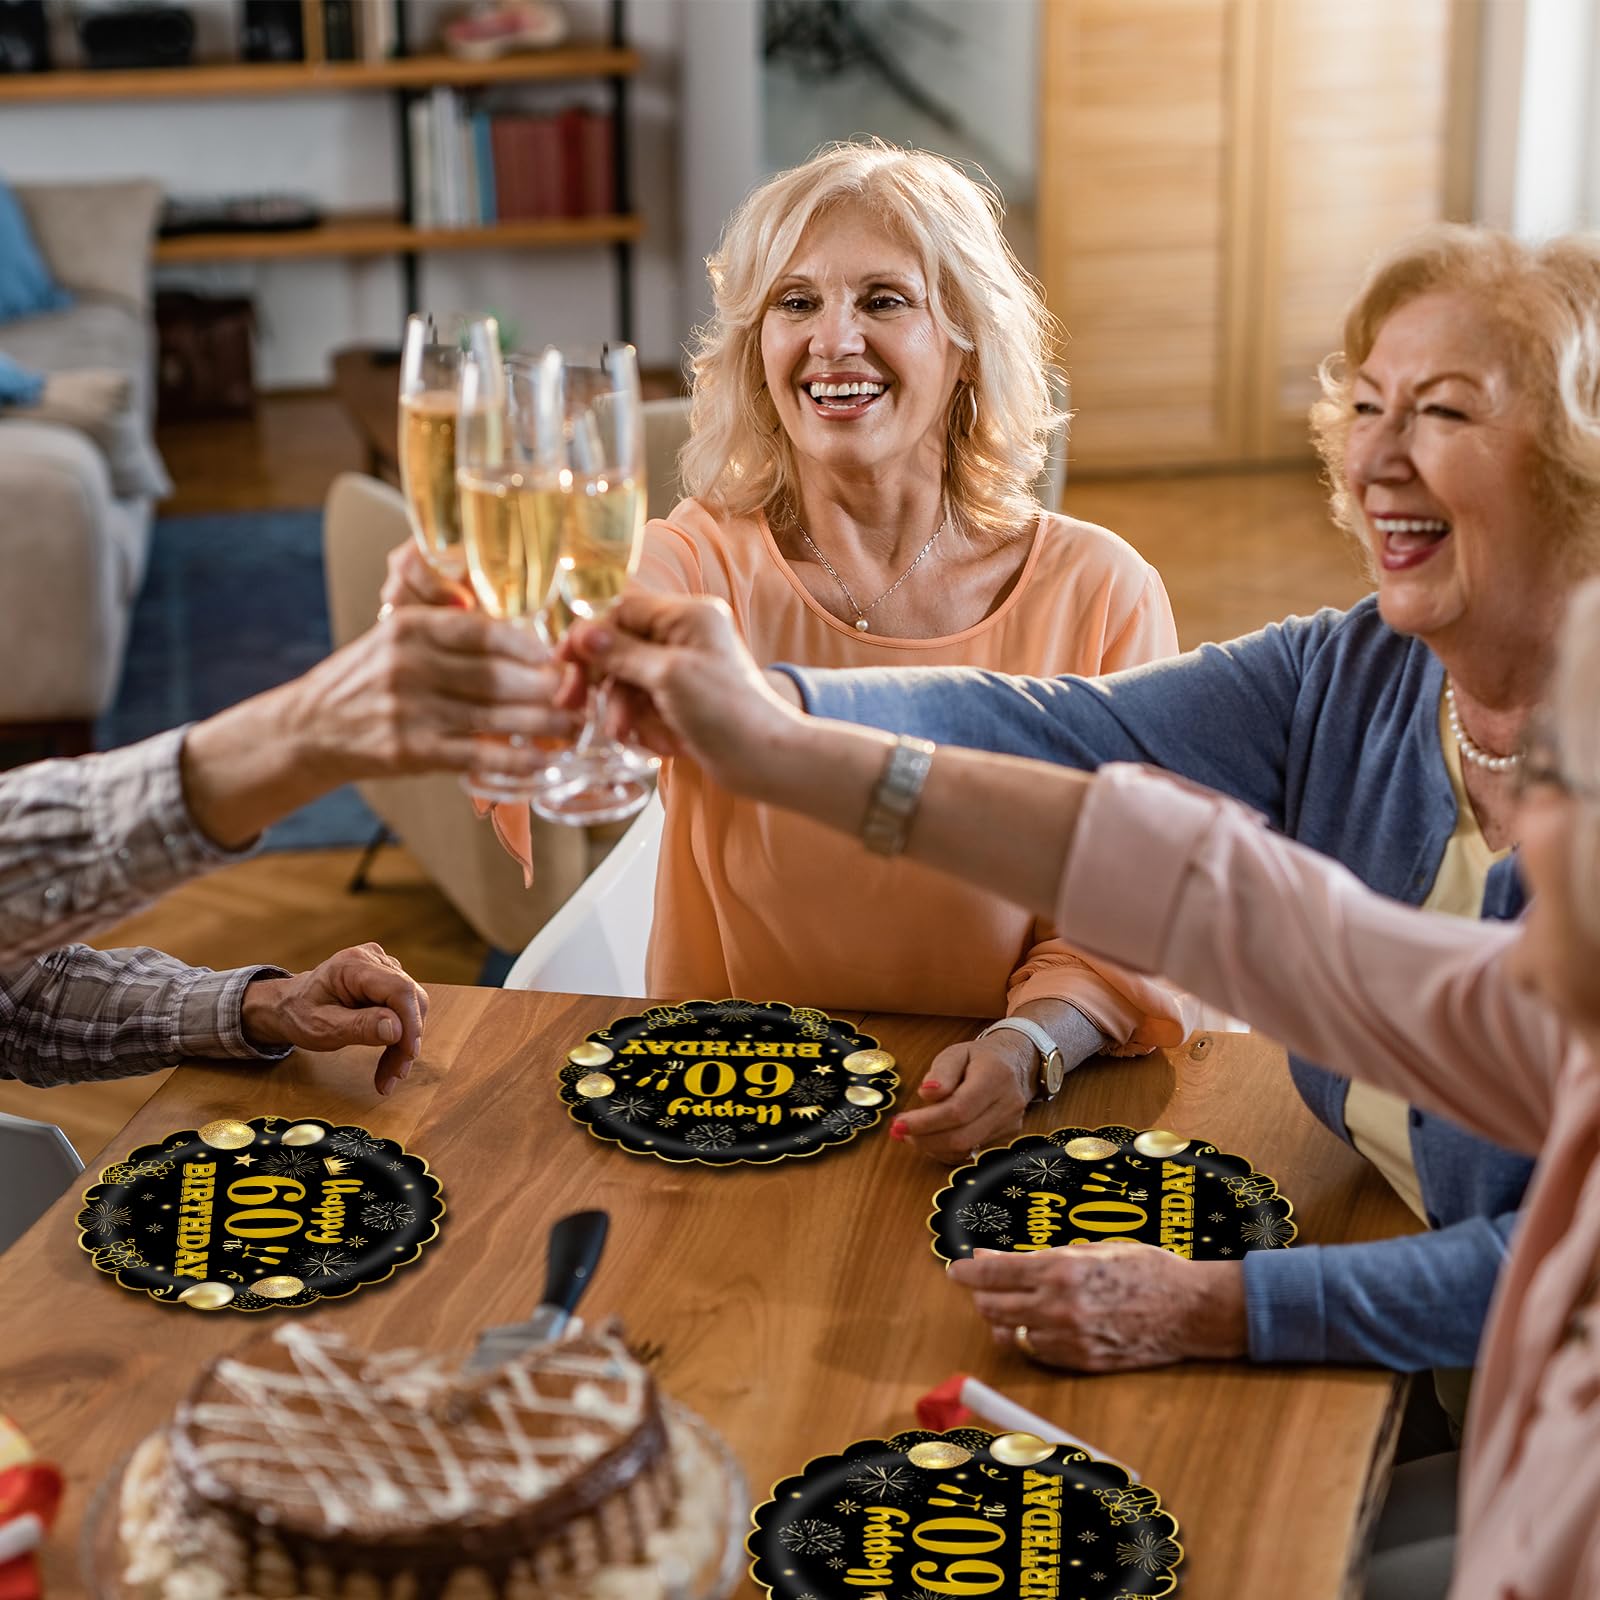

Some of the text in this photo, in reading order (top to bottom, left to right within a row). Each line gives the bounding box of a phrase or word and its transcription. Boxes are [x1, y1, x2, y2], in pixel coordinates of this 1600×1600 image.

[619, 1039, 823, 1058] BIRTHDAY
[667, 1097, 782, 1126] Happy
[174, 1161, 217, 1281] BIRTHDAY
[304, 1178, 364, 1244] Happy
[1158, 1160, 1197, 1260] RTHDAY
[843, 1505, 911, 1587] Happy
[1019, 1469, 1065, 1600] IRTHDAY
